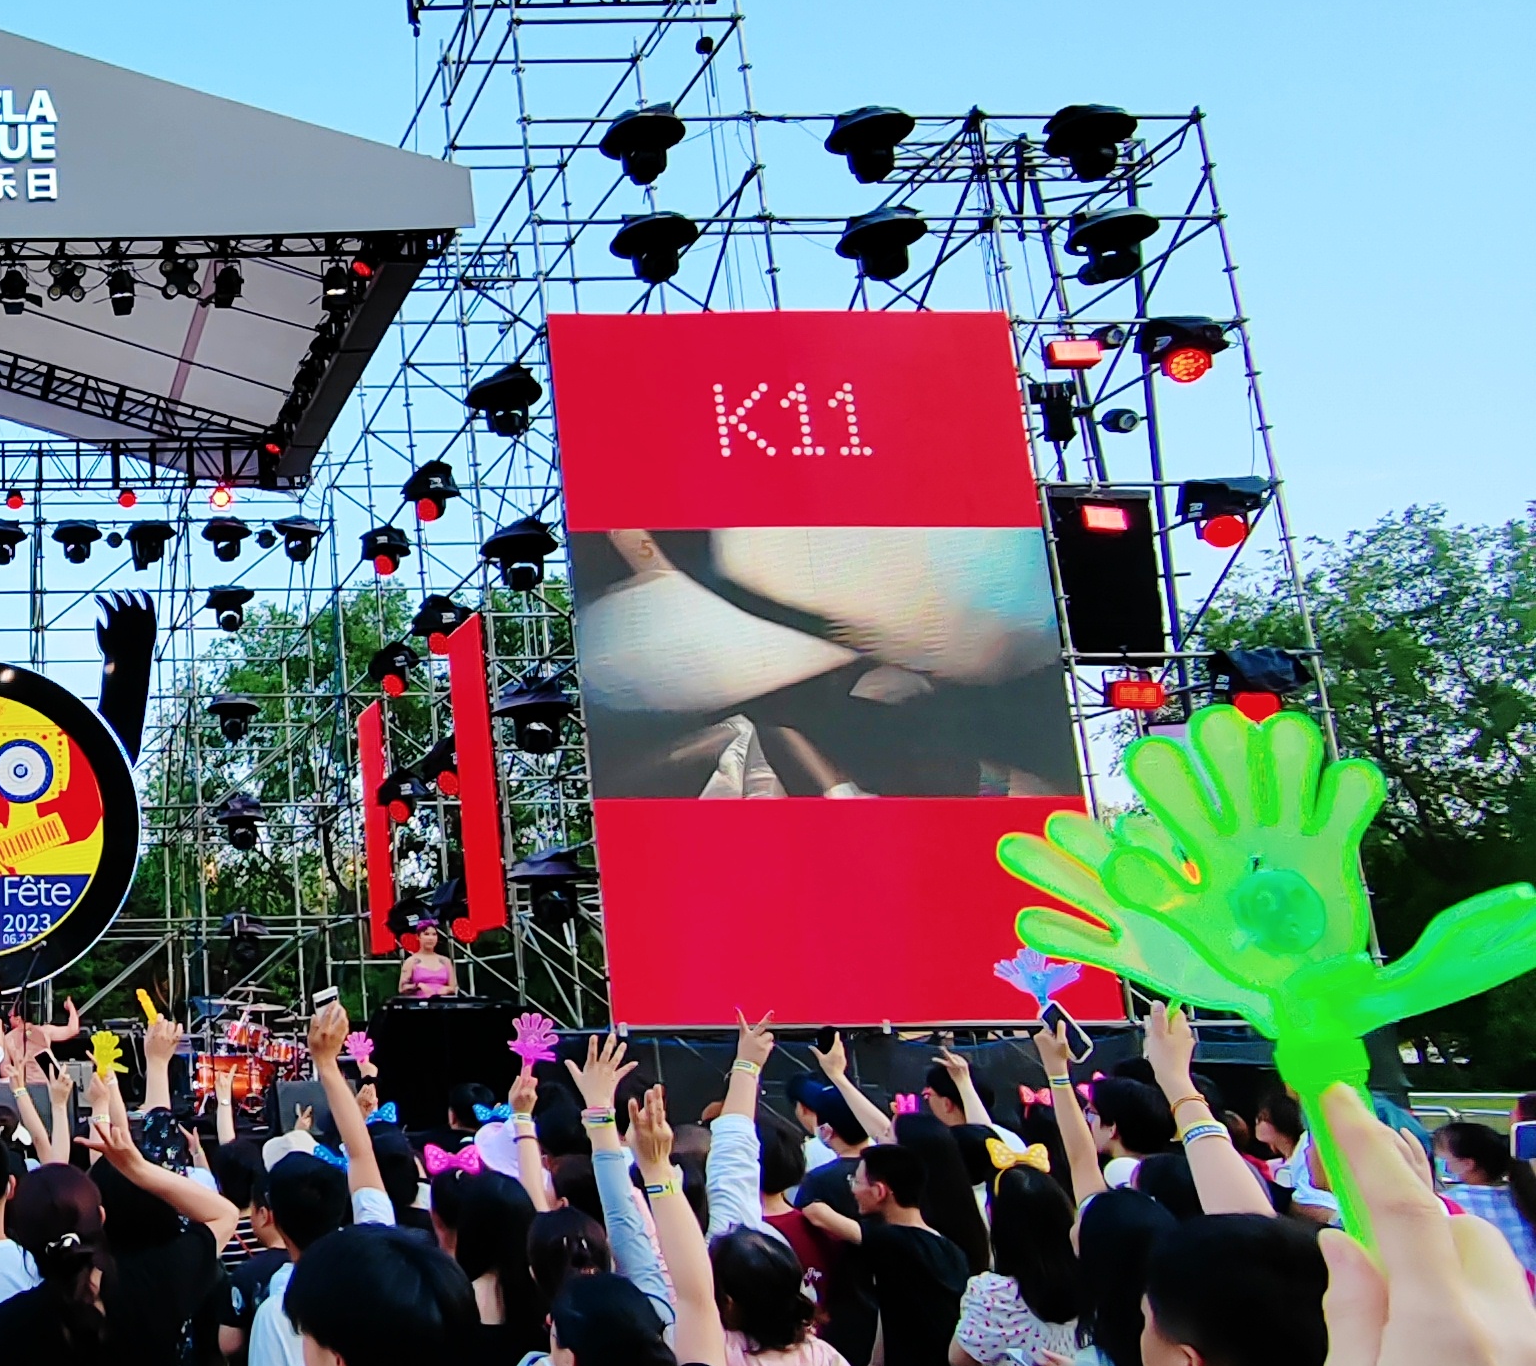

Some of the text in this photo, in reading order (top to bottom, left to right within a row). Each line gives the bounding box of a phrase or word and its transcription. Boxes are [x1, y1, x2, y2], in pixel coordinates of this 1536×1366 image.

[713, 382, 874, 458] K11
[4, 875, 71, 906] Fête
[3, 914, 51, 932] 2023
